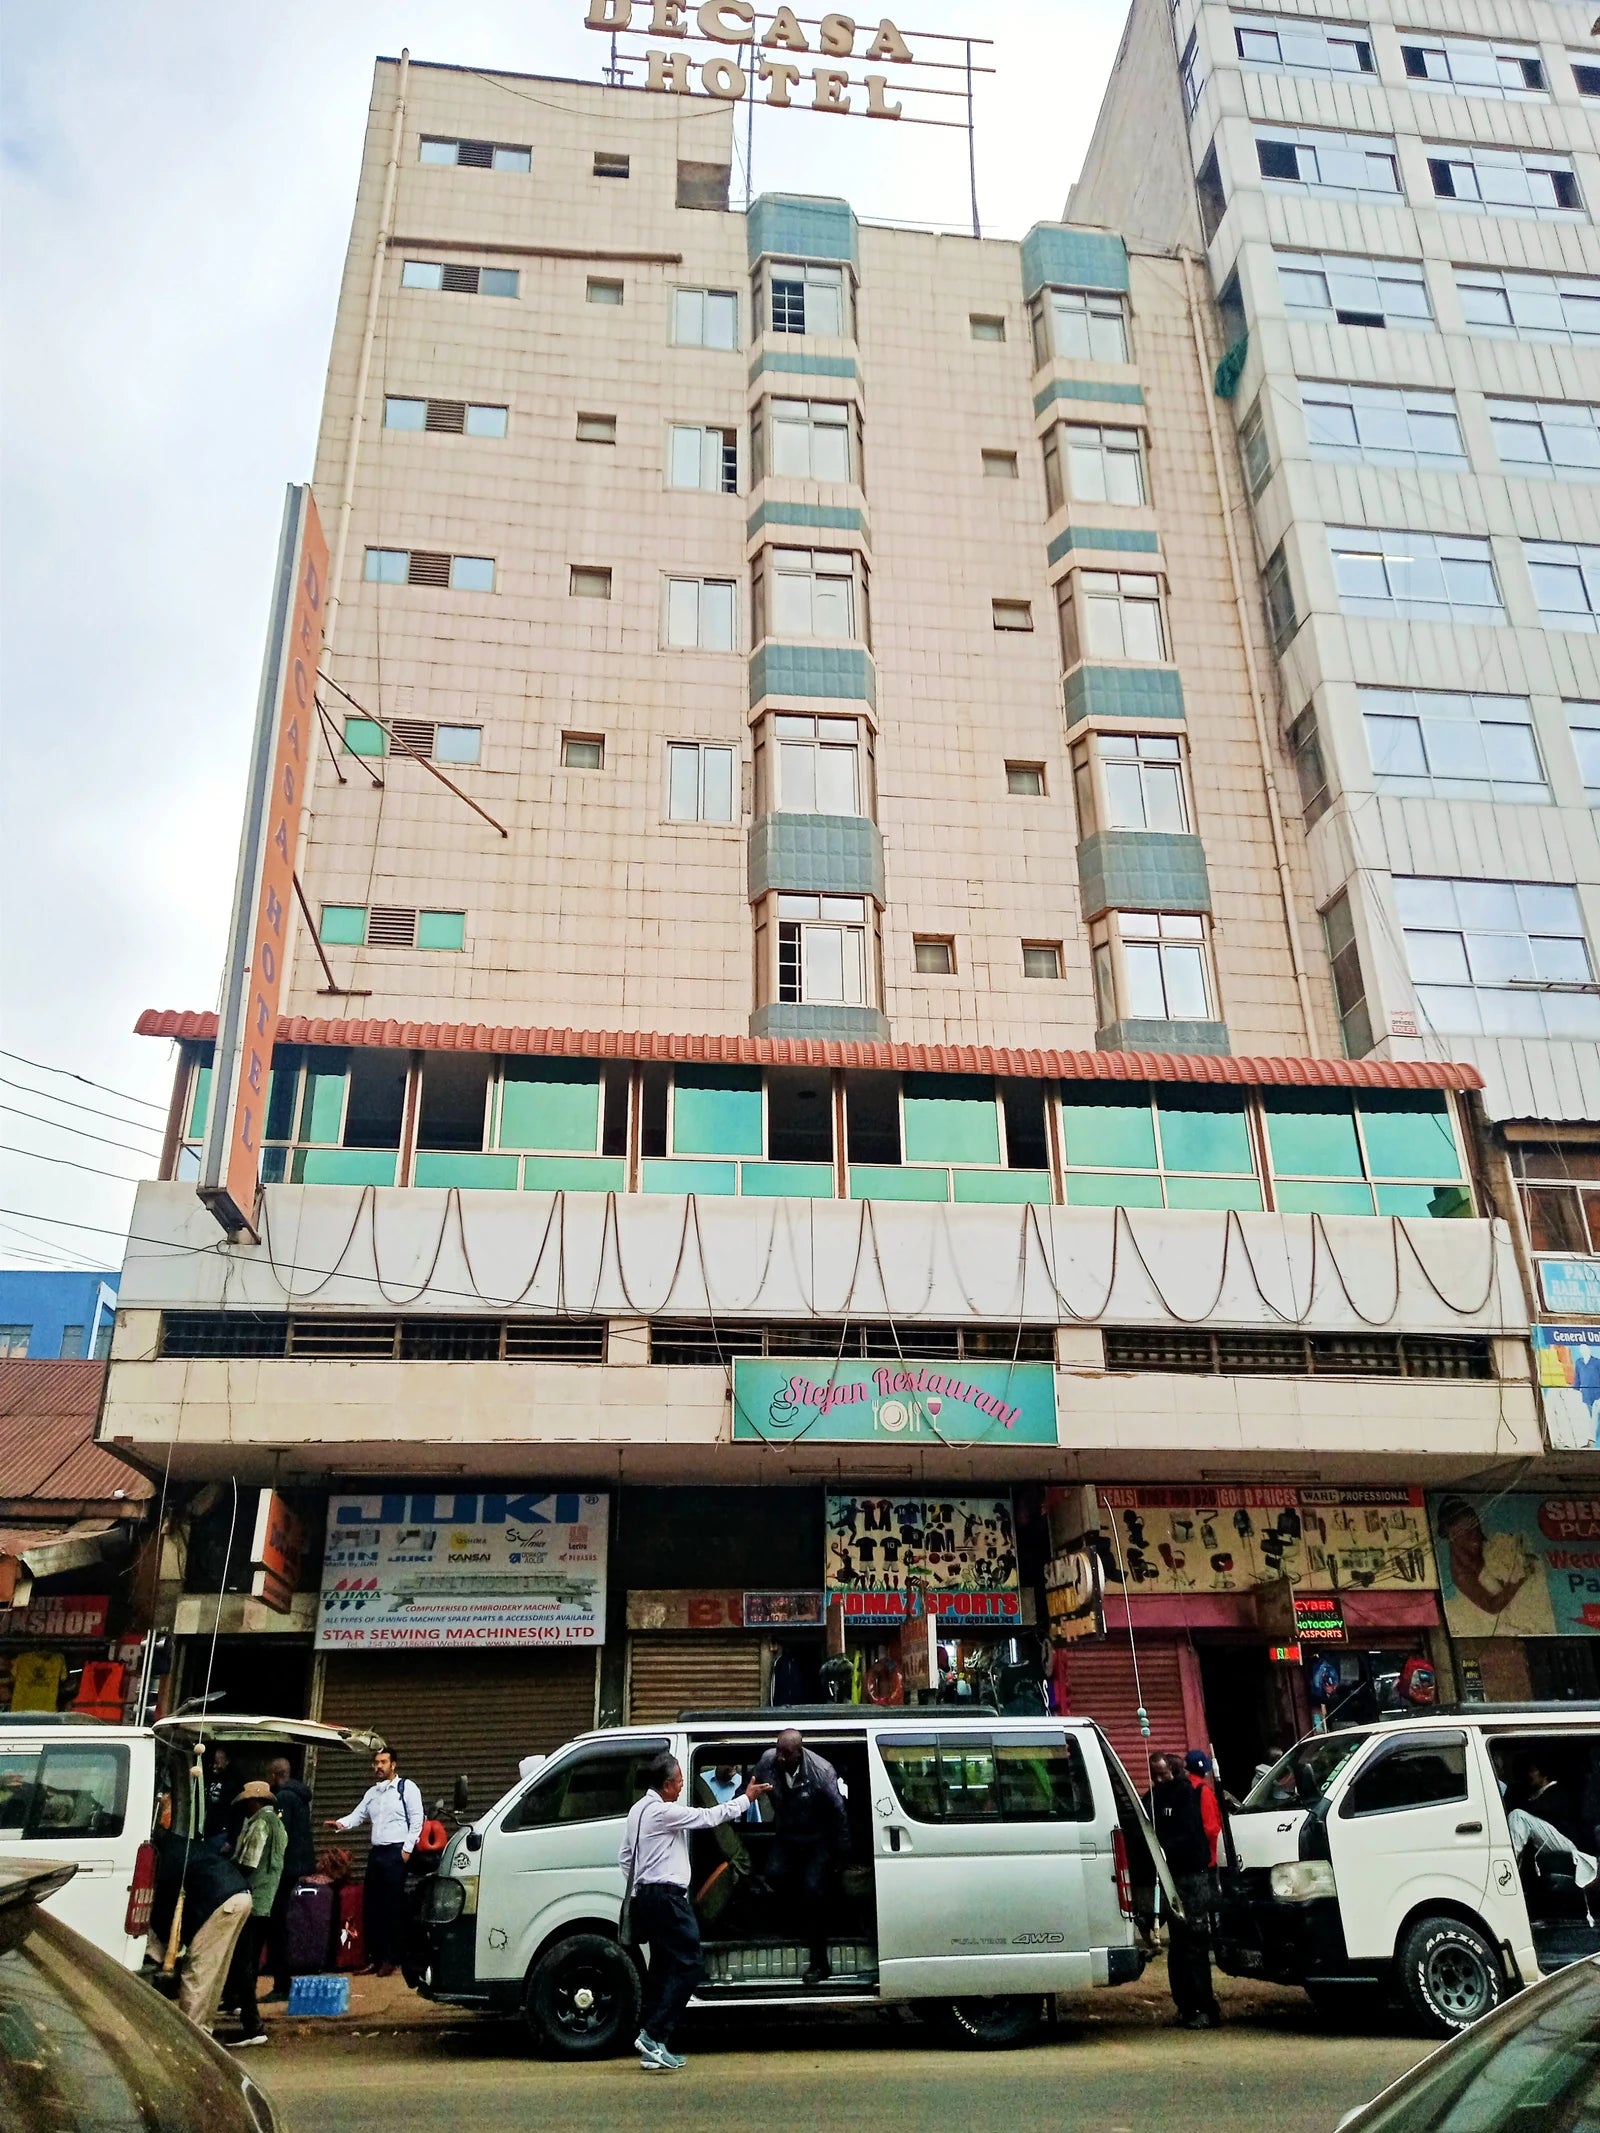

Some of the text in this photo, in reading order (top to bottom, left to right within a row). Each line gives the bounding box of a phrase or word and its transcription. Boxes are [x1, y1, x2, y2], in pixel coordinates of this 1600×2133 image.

[584, 0, 913, 63] DECASA
[645, 50, 901, 119] HOTEL
[241, 553, 319, 1153] DECASA HOTEL
[1553, 1331, 1585, 1342] General
[872, 1367, 1023, 1429] Restaurant
[1255, 1488, 1297, 1506] PRICES
[1303, 1490, 1410, 1502] WAHL PROFESSIONAL
[337, 1495, 579, 1524] JUKI
[448, 1554, 491, 1562] KANSAI
[322, 1591, 381, 1599] TAJIMA
[523, 1603, 561, 1611] MACHINE
[925, 1592, 1019, 1615] SPORTS
[1295, 1600, 1335, 1611] CYBER
[1297, 1611, 1339, 1619] RINTING
[322, 1627, 595, 1640] STAR SEWING MACHINES(K) LTD
[1299, 1630, 1343, 1639] ASSPORTS
[1011, 1932, 1065, 1945] 4WD
[1425, 1930, 1484, 1953] MAXXIS
